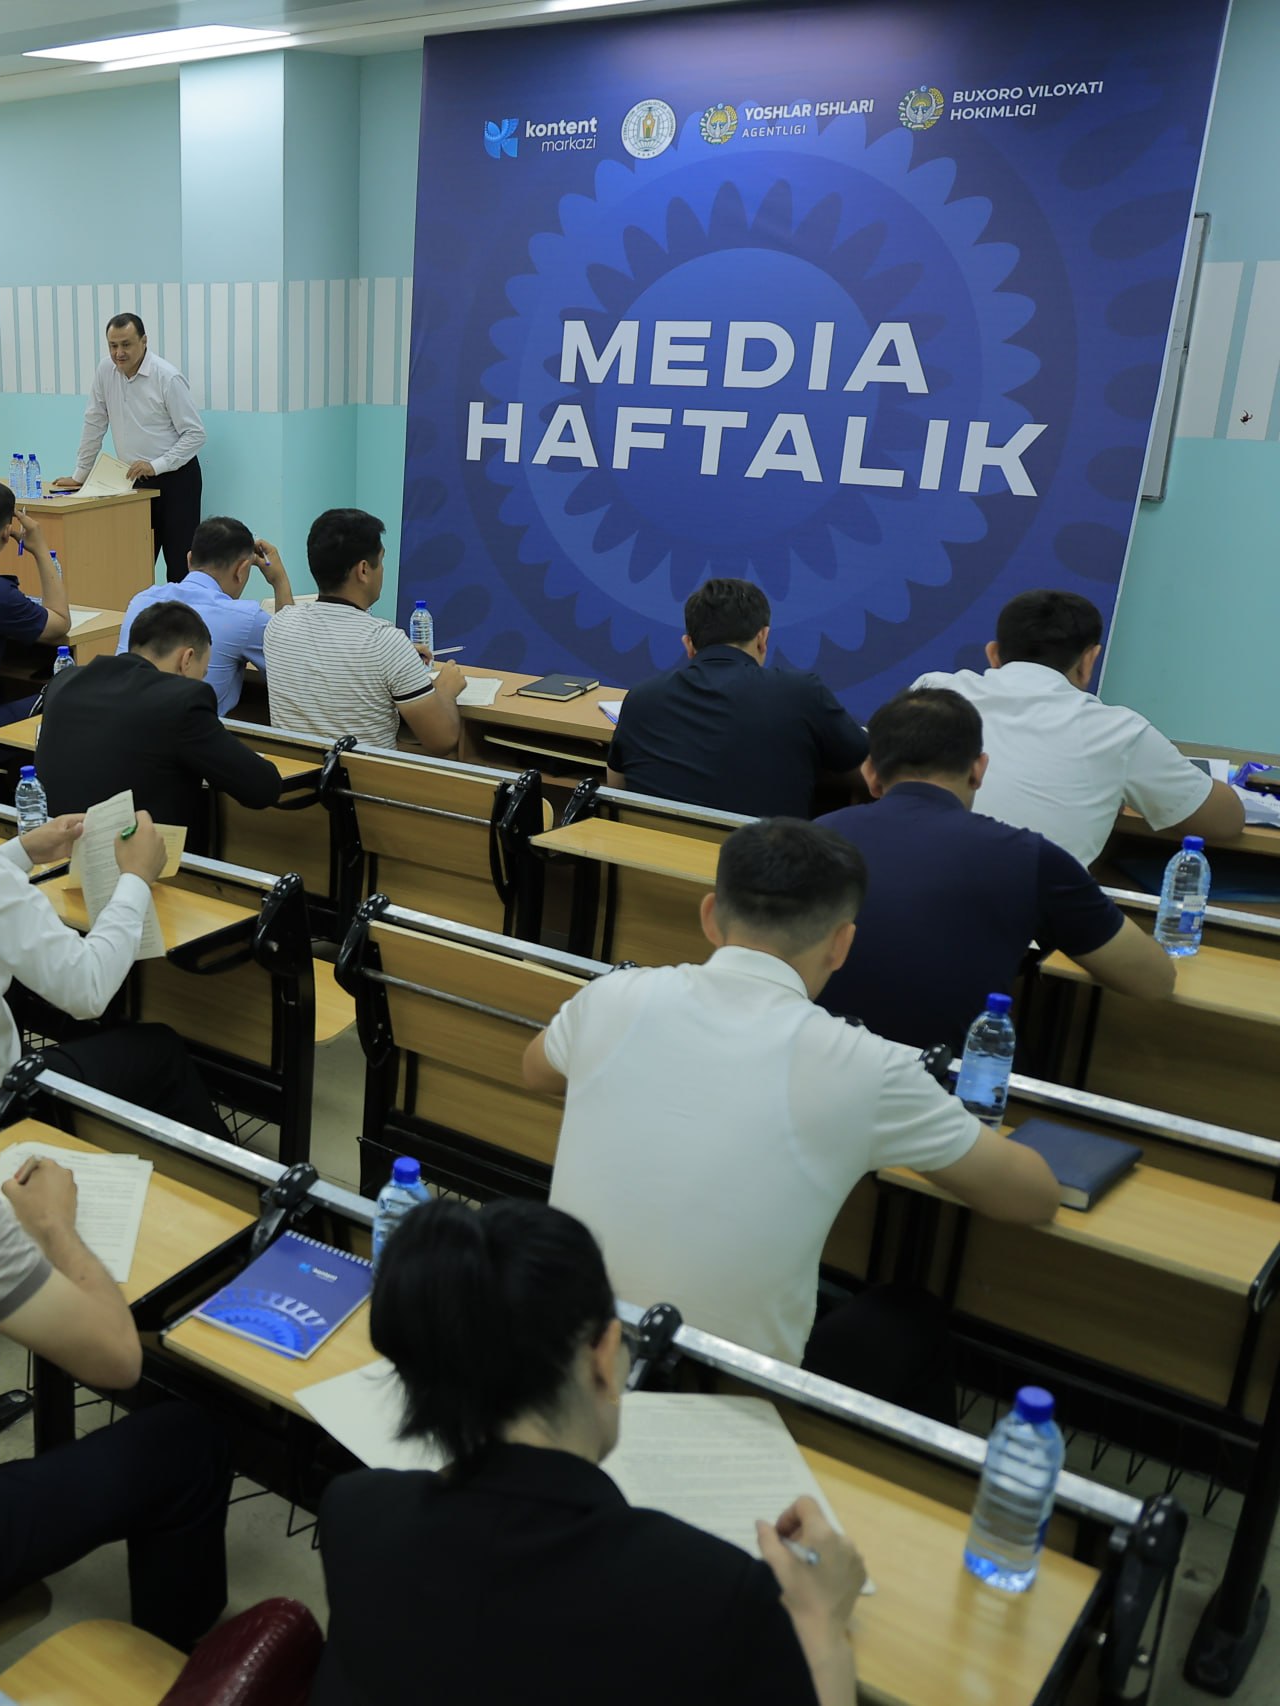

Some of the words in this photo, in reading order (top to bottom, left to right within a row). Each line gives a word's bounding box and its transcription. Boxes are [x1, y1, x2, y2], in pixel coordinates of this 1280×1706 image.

[952, 86, 1023, 103] BUXORO
[1027, 81, 1104, 99] VILOYATI
[744, 104, 811, 121] YOSHLAR
[815, 99, 874, 116] ISHLARI
[949, 103, 1037, 121] HOKIMLIGI
[525, 116, 598, 138] kontent
[741, 124, 806, 138] AGENTLIGI
[541, 134, 597, 153] markazi
[559, 320, 929, 394] MEDIA
[466, 401, 1048, 497] HAFTALIK
